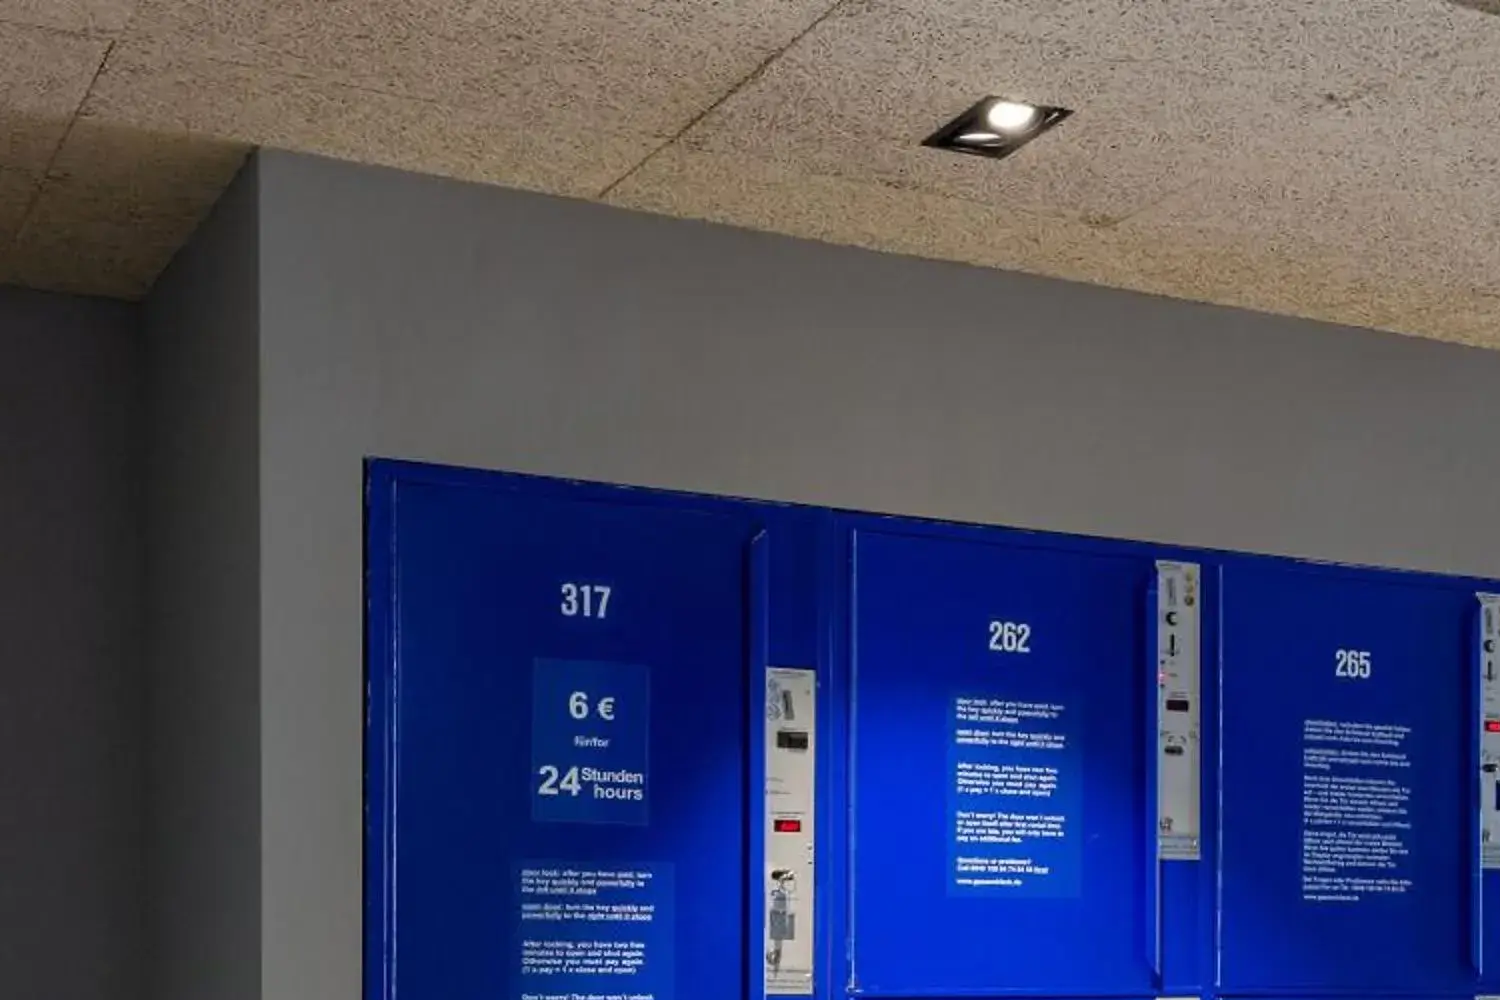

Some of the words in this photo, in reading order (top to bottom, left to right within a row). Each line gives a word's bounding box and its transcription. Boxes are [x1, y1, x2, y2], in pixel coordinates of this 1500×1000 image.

[560, 583, 611, 618] 317
[989, 621, 1031, 653] 262
[1335, 650, 1371, 678] 265
[569, 691, 589, 719] 6
[597, 697, 615, 720] €
[538, 765, 581, 796] 24
[581, 767, 643, 784] Stunden
[593, 783, 643, 801] hours
